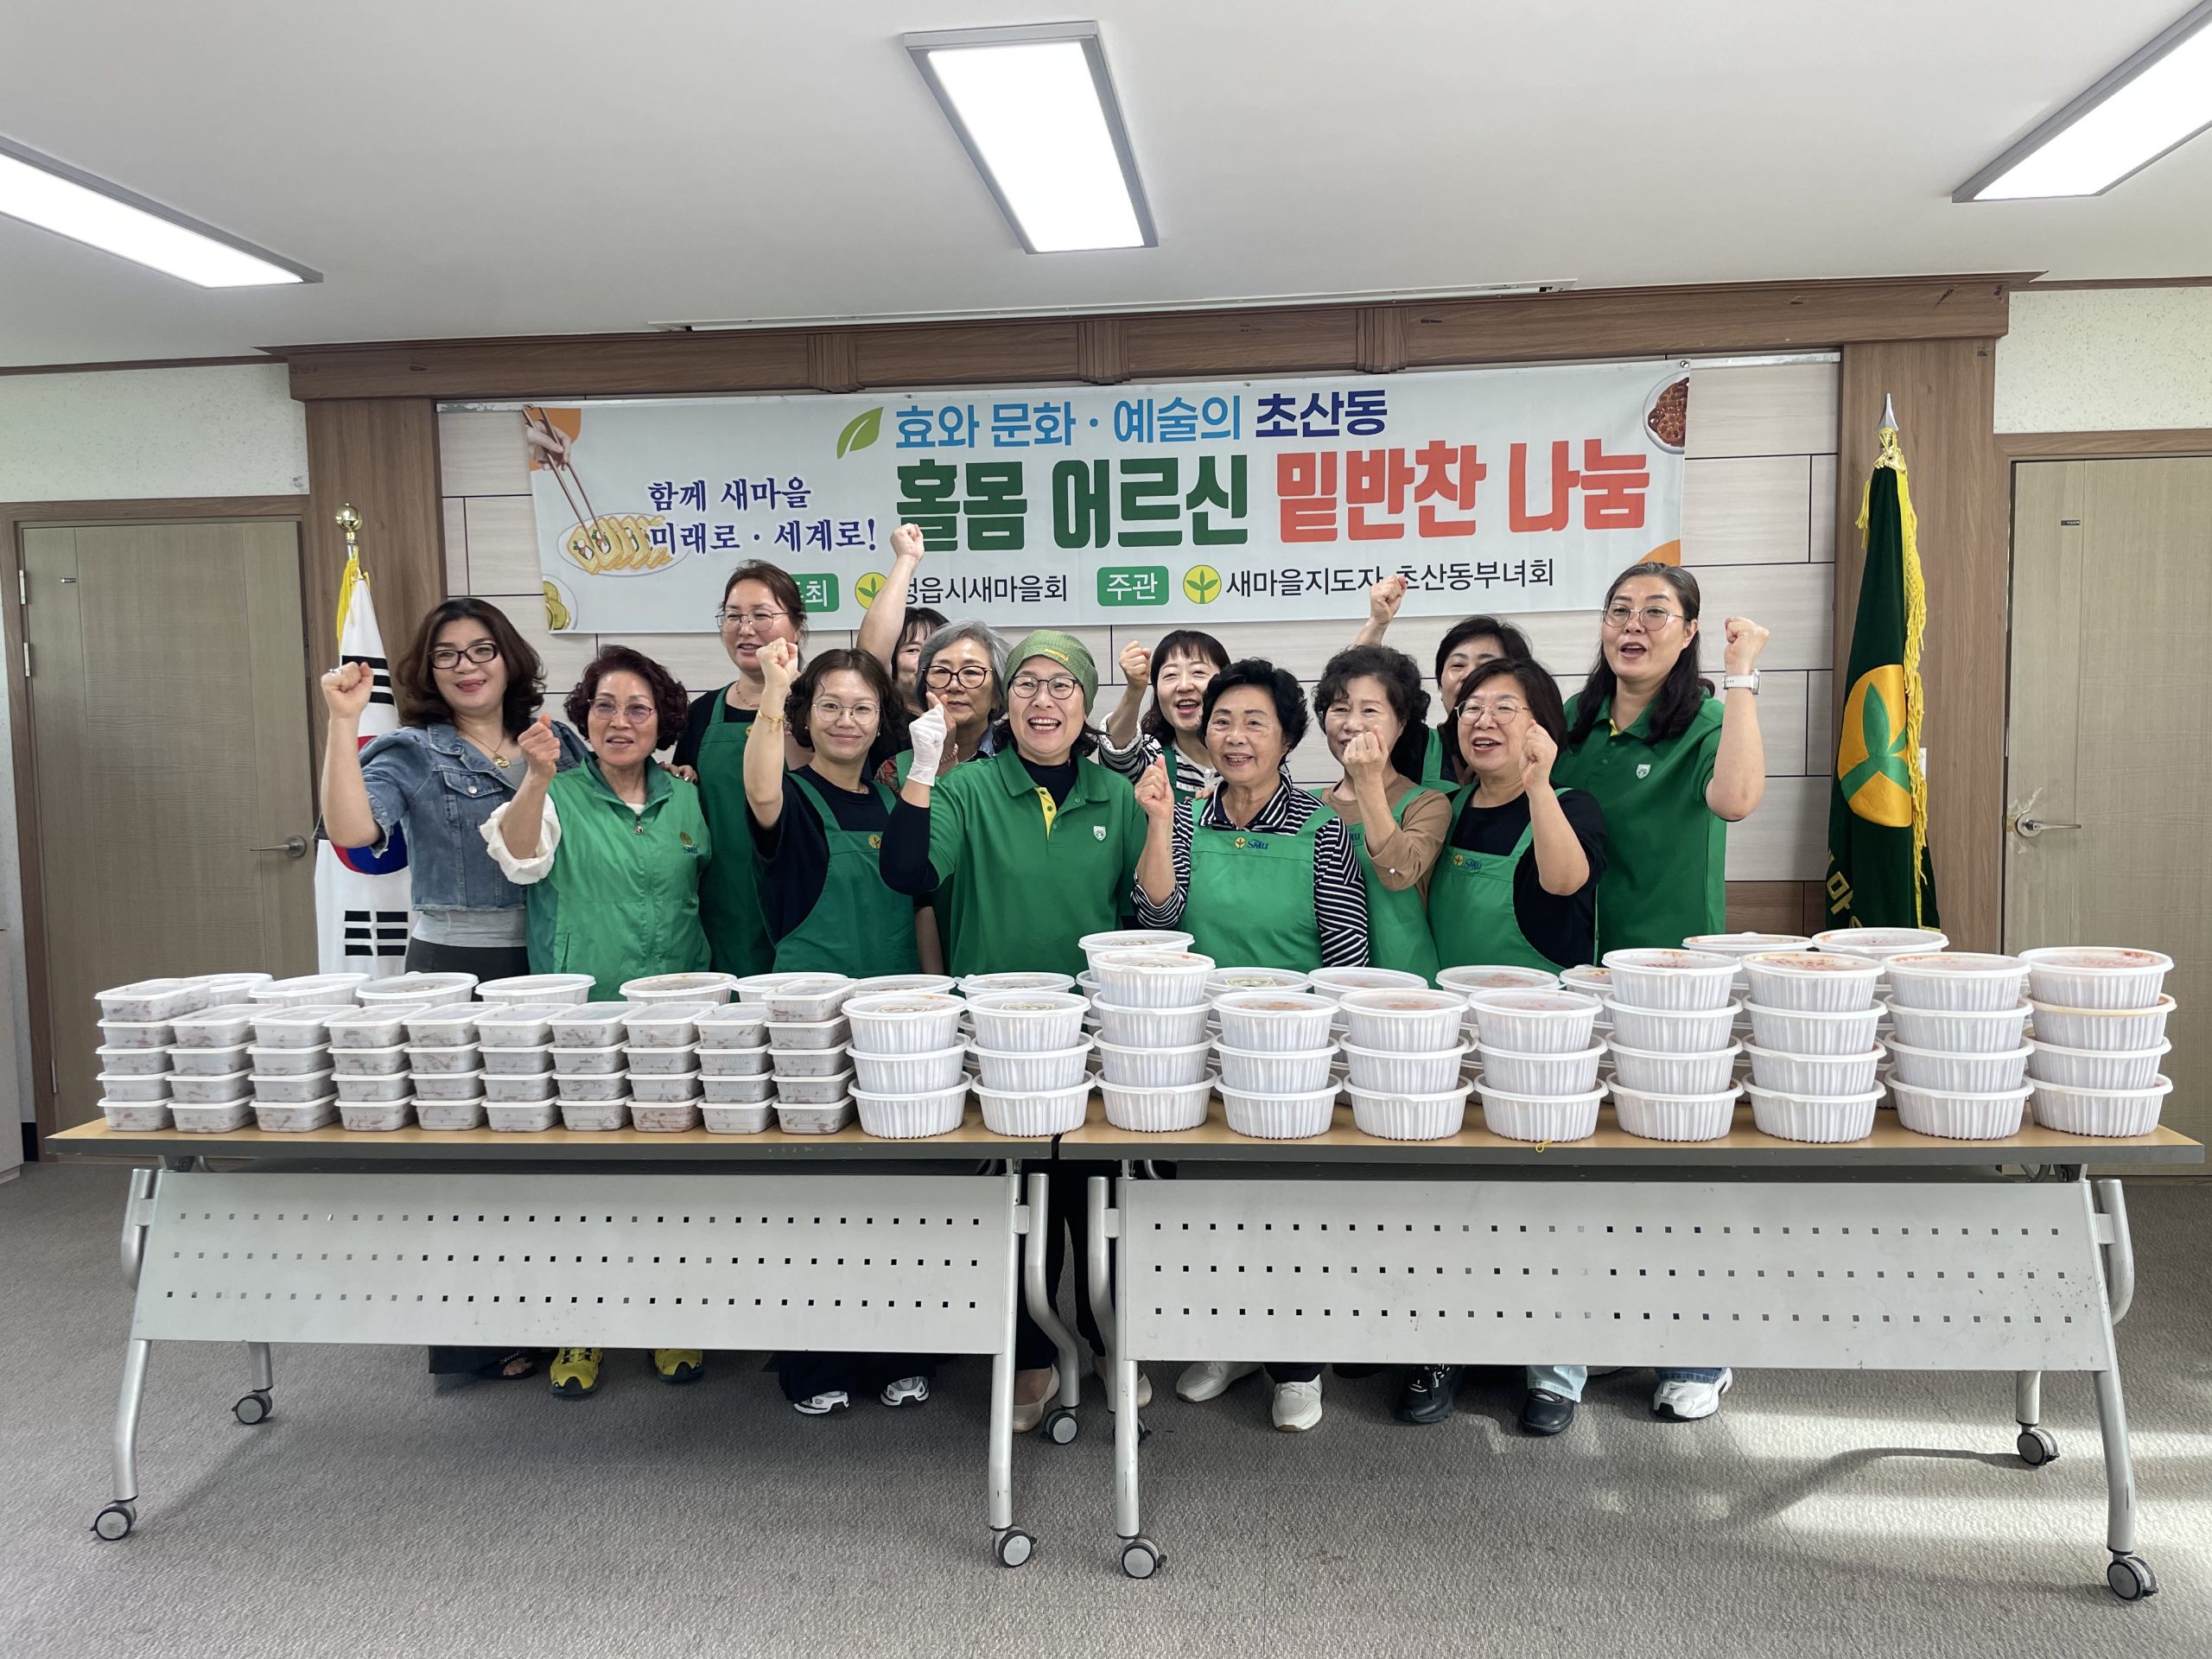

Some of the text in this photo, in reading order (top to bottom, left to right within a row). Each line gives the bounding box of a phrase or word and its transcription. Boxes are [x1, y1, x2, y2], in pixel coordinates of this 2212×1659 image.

[895, 404, 980, 448] 효와
[990, 401, 1077, 447] 문화
[1113, 395, 1241, 442] 예술의
[1255, 389, 1388, 438] 초산동
[647, 476, 811, 512] 함께 새마을
[896, 438, 1650, 553] 홀몸 어르신 밑반찬 나눔
[650, 522, 741, 555] 미래로
[773, 518, 876, 553] 세계로!
[797, 580, 828, 607] 최
[1106, 572, 1158, 601] 주관
[1225, 558, 1554, 598] 새마을지도자 초산동부녀회
